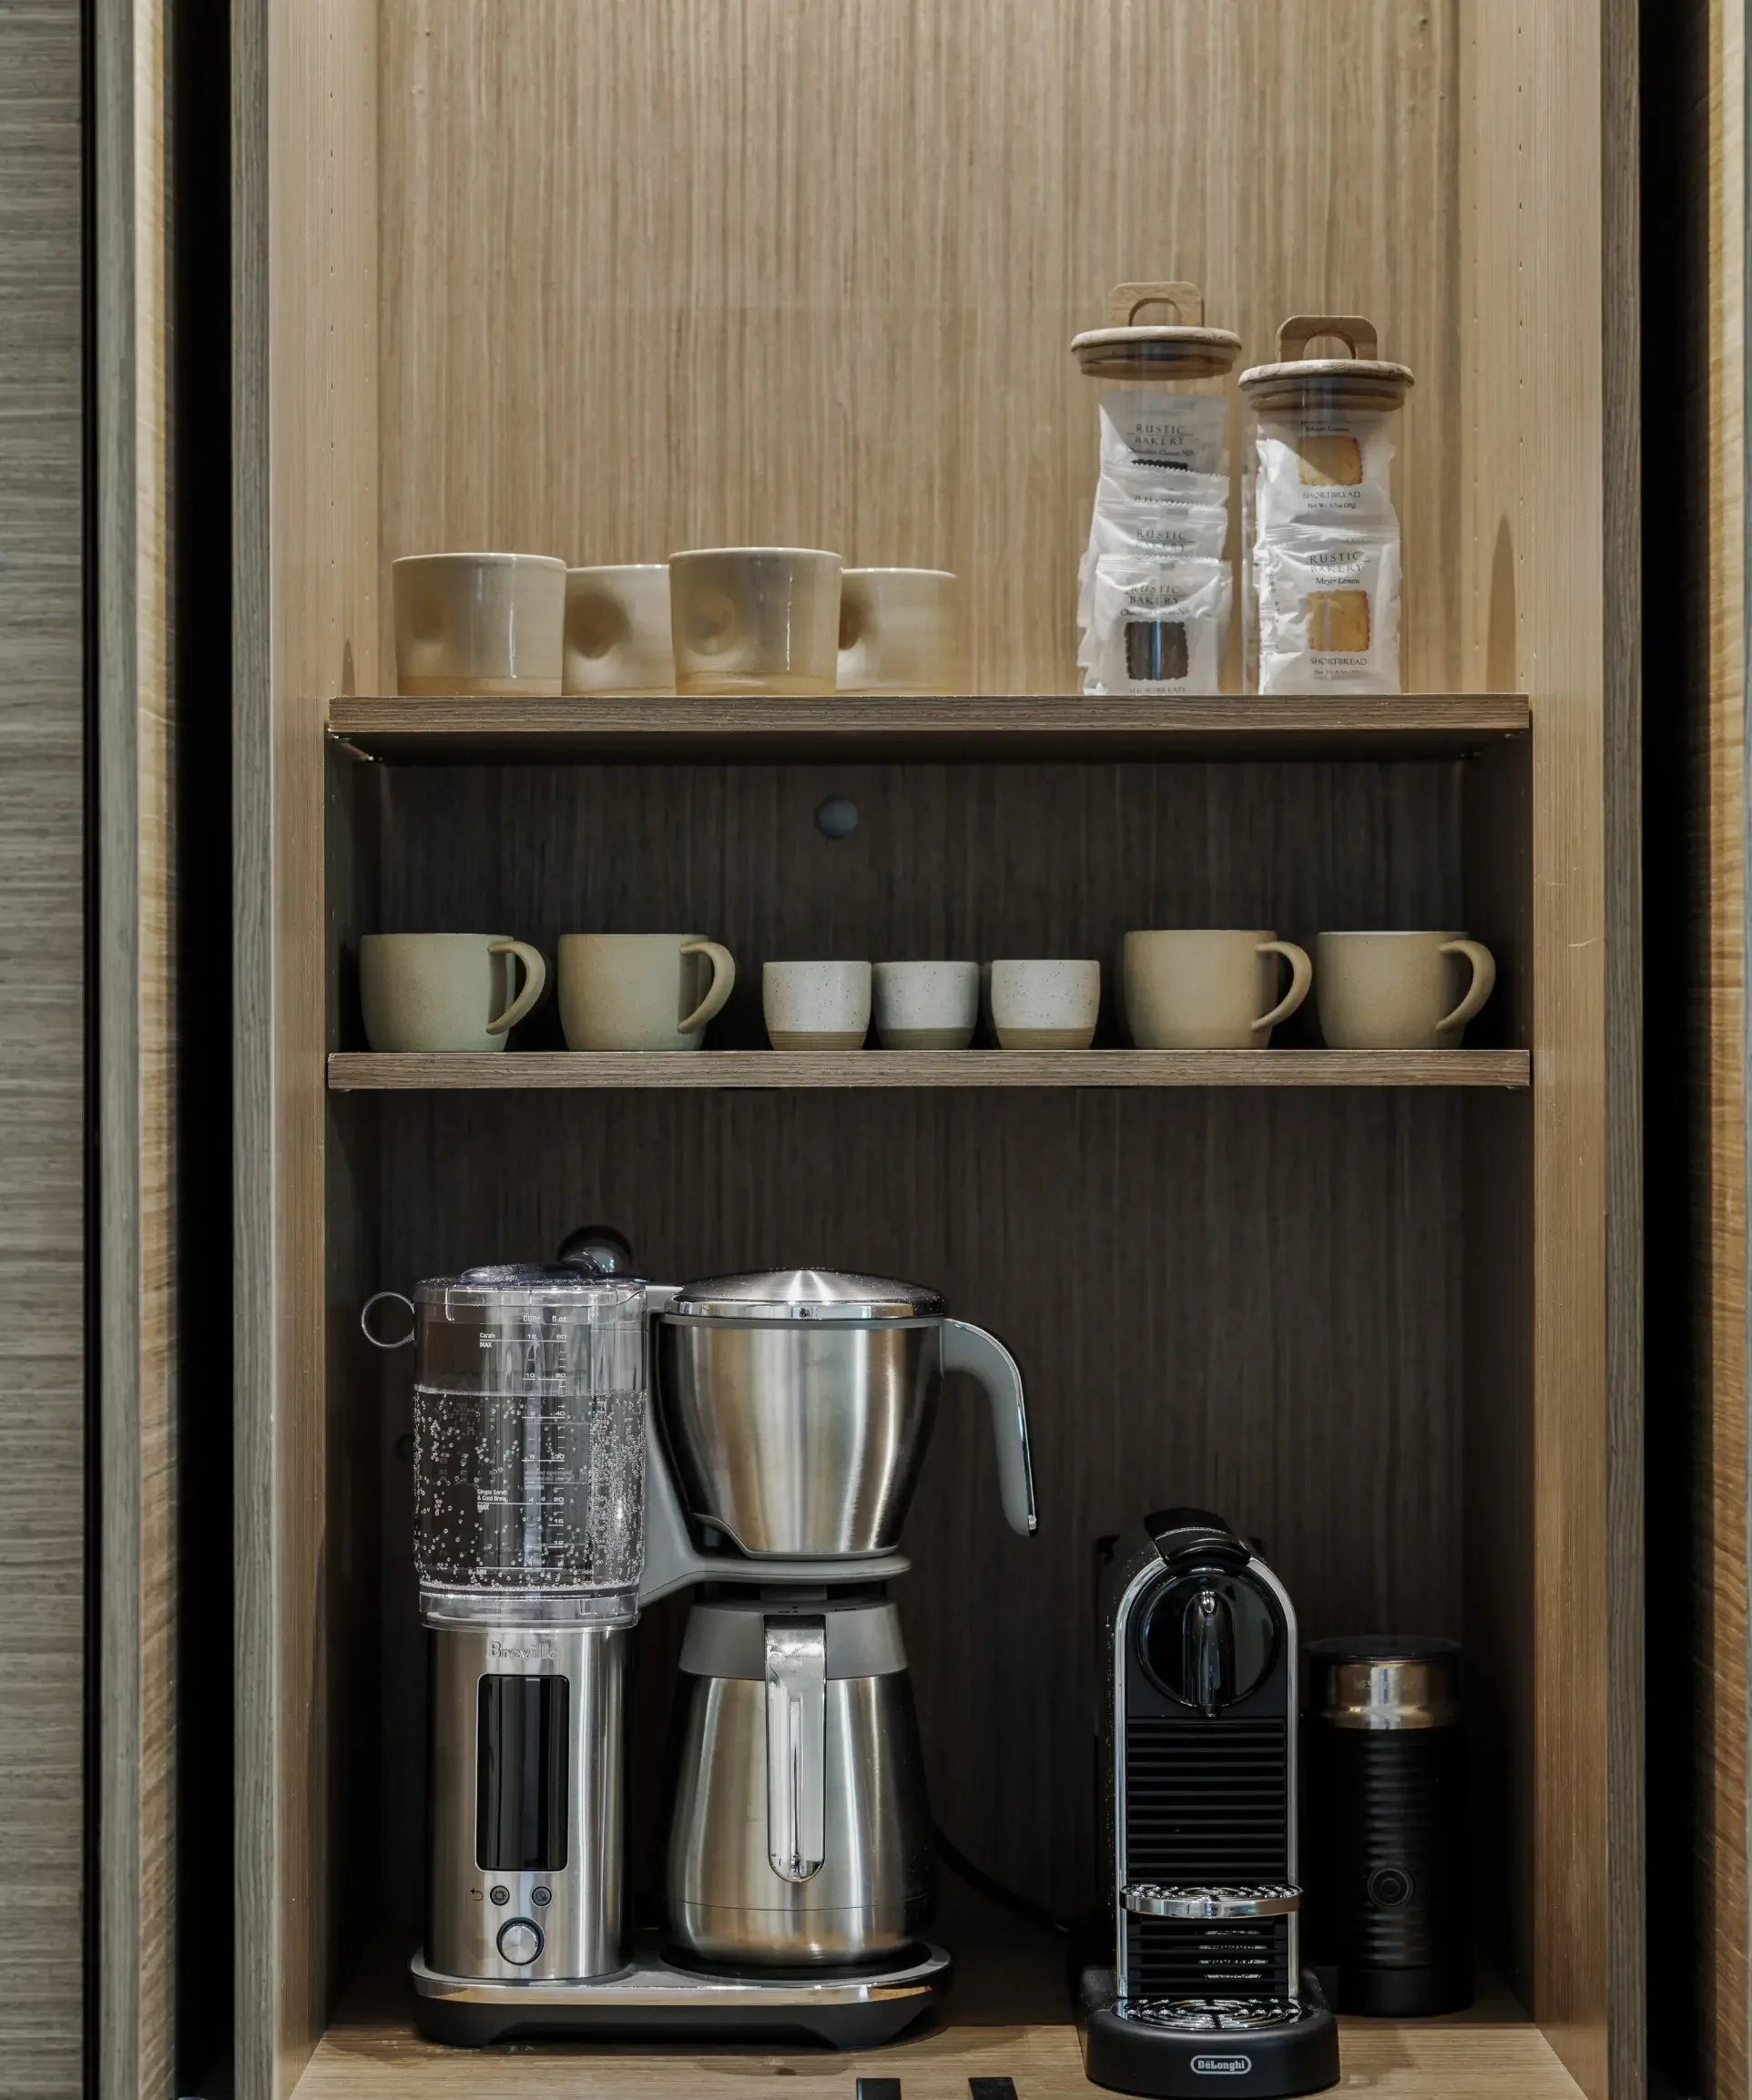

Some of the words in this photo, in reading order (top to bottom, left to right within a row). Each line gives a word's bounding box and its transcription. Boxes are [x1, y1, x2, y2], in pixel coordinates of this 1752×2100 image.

[1136, 423, 1185, 434] RUSTIC
[1135, 436, 1184, 446] BAKERY
[1302, 491, 1361, 500] SHORTBREAD
[1136, 528, 1184, 540] RUSTIC
[1310, 551, 1361, 564] RUSTIC
[1311, 564, 1362, 574] BAKERY
[1316, 576, 1337, 586] Meyer
[1338, 576, 1360, 585] Lemon
[1131, 586, 1180, 595] RUSTIC
[1130, 596, 1180, 606] BAKERY
[1310, 658, 1368, 666] SHORTBREAD
[489, 1641, 558, 1660] Breville
